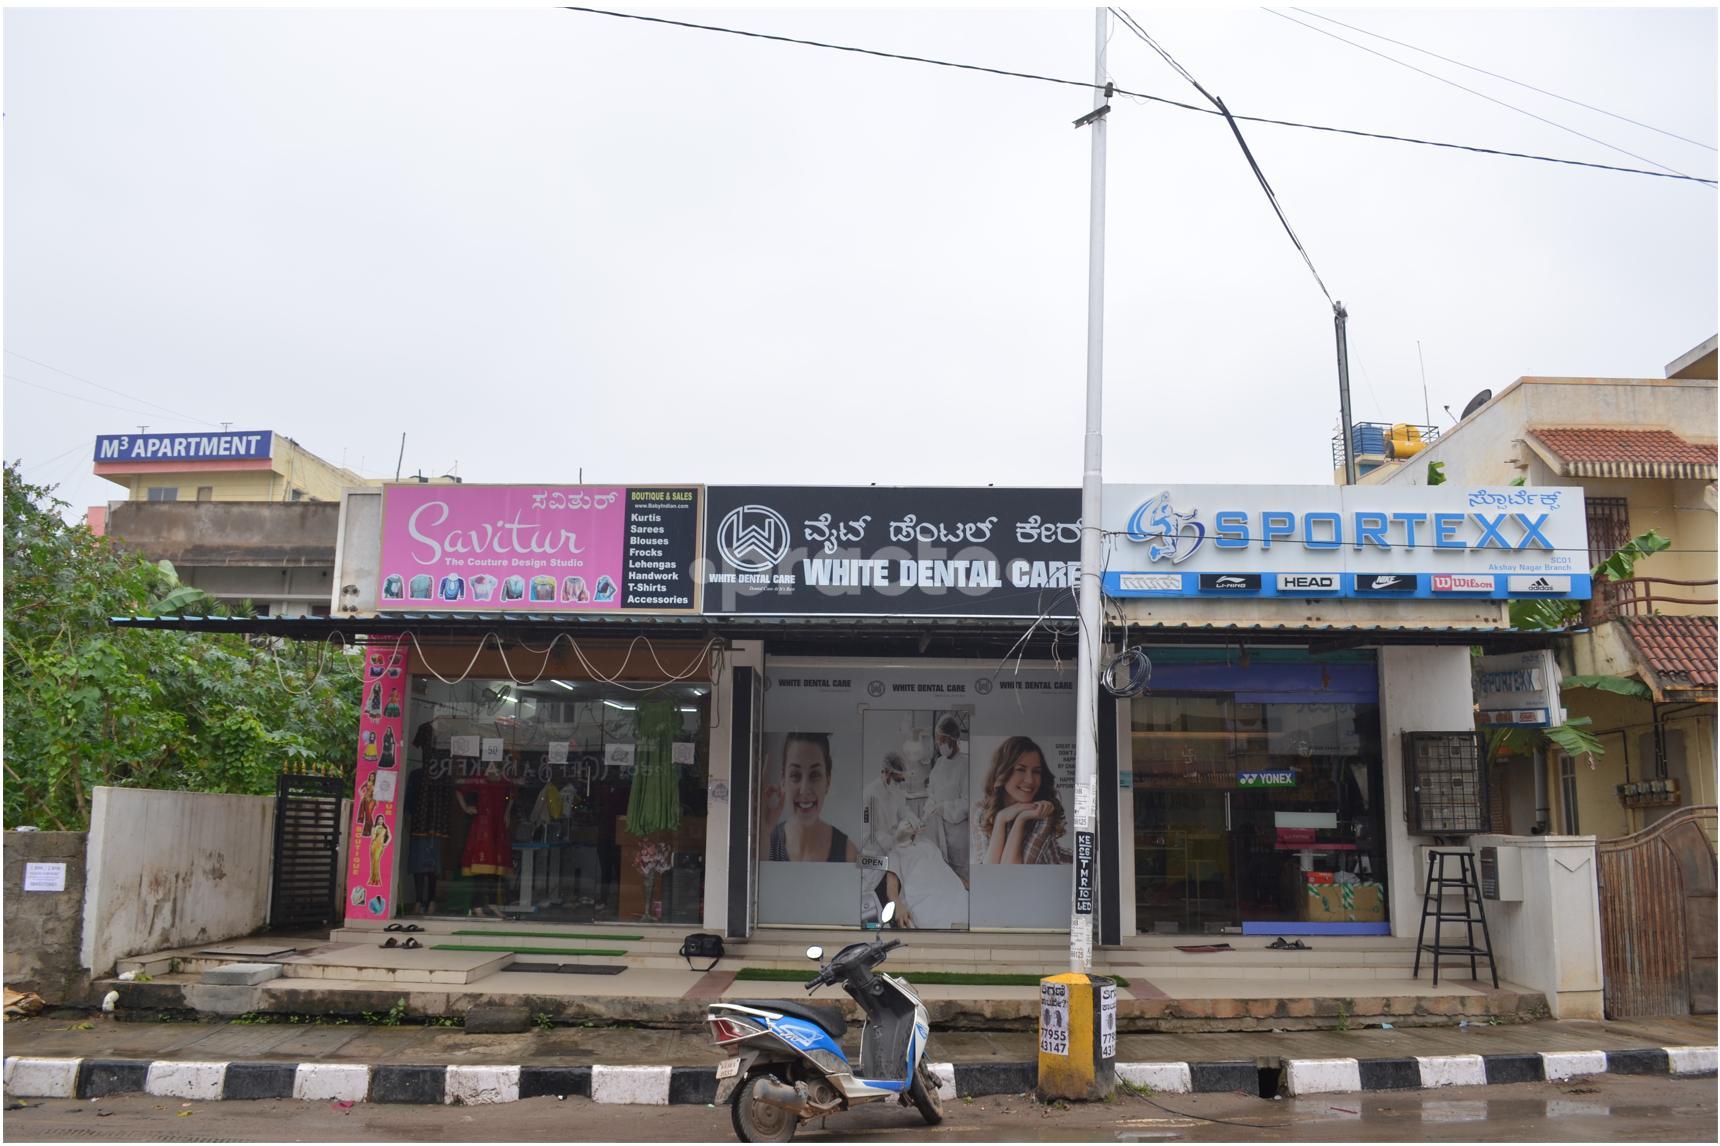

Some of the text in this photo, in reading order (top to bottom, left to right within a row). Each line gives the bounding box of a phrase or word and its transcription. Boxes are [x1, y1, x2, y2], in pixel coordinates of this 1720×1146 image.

[131, 435, 261, 458] APARTMENT
[532, 490, 619, 510] ಸವಿತುರ್
[631, 491, 693, 501] BOUTIQUE & SALES
[631, 513, 661, 522] Kurtis
[408, 501, 585, 566] Savitur
[630, 525, 664, 534] Sarees
[803, 513, 872, 554] ವೈಟ್
[889, 514, 998, 543] ಡೆಂಟಲ್
[1214, 511, 1555, 551] SPORTEXX
[630, 536, 669, 545] Blouses
[629, 548, 663, 557] Frocks
[445, 557, 583, 568] The Couture Design Studio
[628, 560, 677, 570] Lehengas
[803, 558, 1081, 588] WHITE DENTAL CARE
[1488, 564, 1517, 572] Akshay
[1519, 564, 1541, 572] Nagar
[628, 571, 679, 580] Handwork
[709, 573, 796, 584] WHITE DENTAL CARE
[627, 583, 667, 592] T-Shirts
[1284, 577, 1333, 588] HEAD
[1453, 577, 1493, 589] Wilson
[627, 594, 689, 604] Accessories
[778, 679, 852, 688] WHITE DENTAL CARE
[892, 683, 966, 693] WHITE DENTAL CARE
[1024, 681, 1052, 690] DENTAL
[1053, 681, 1073, 690] CARE
[1260, 773, 1293, 784] YONEX
[1079, 835, 1091, 845] KE
[861, 858, 883, 867] OPEN
[1077, 901, 1092, 911] LED
[1041, 1028, 1066, 1041] 77955
